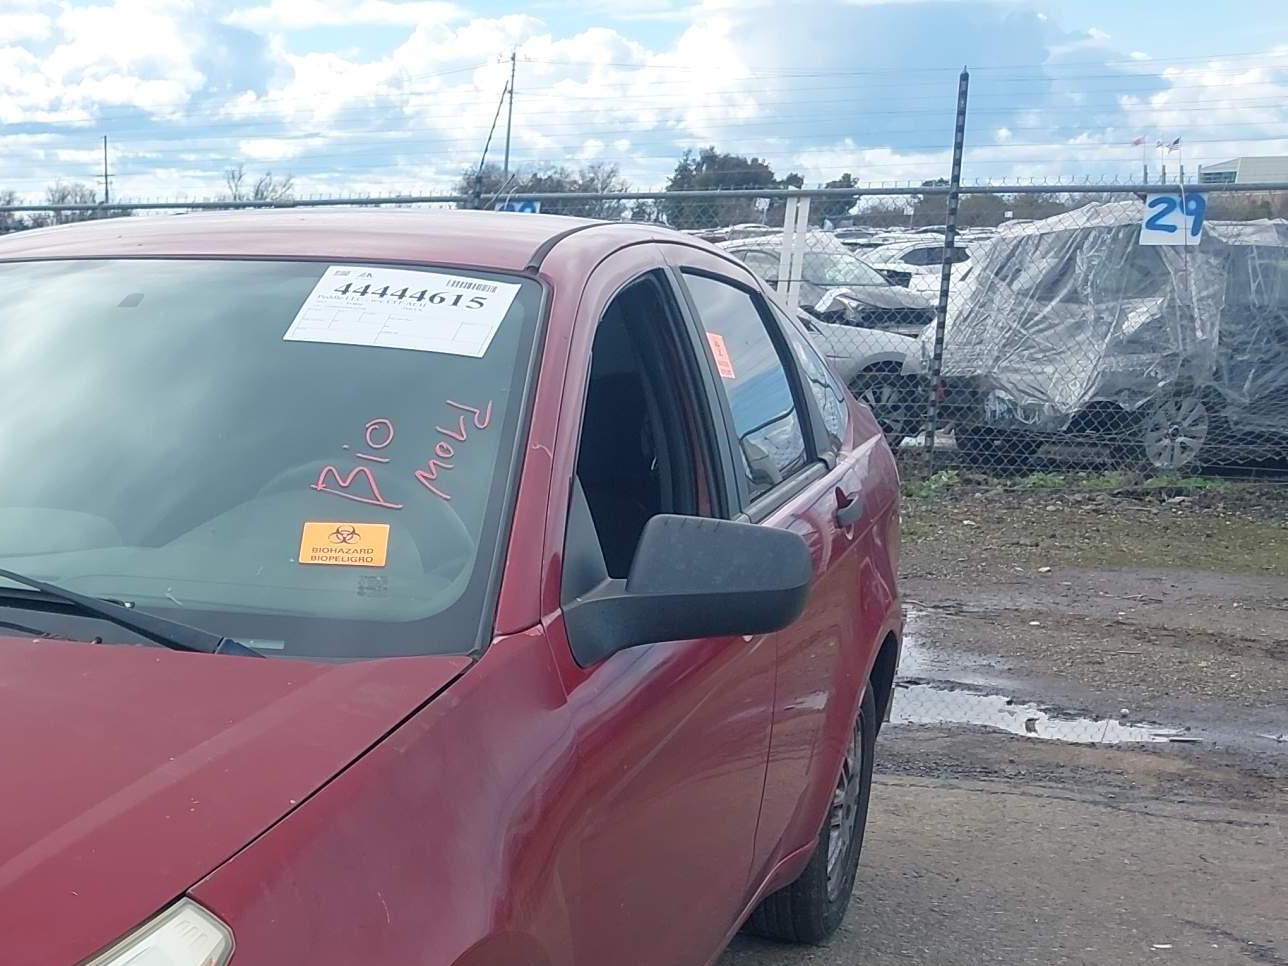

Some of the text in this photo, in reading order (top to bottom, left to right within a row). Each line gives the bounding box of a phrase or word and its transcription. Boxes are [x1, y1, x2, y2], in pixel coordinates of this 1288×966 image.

[1145, 192, 1206, 236] 29
[334, 282, 488, 309] 44444615
[310, 555, 374, 563] BIOPELIGRO
[311, 546, 374, 555] BIOHAZARD
